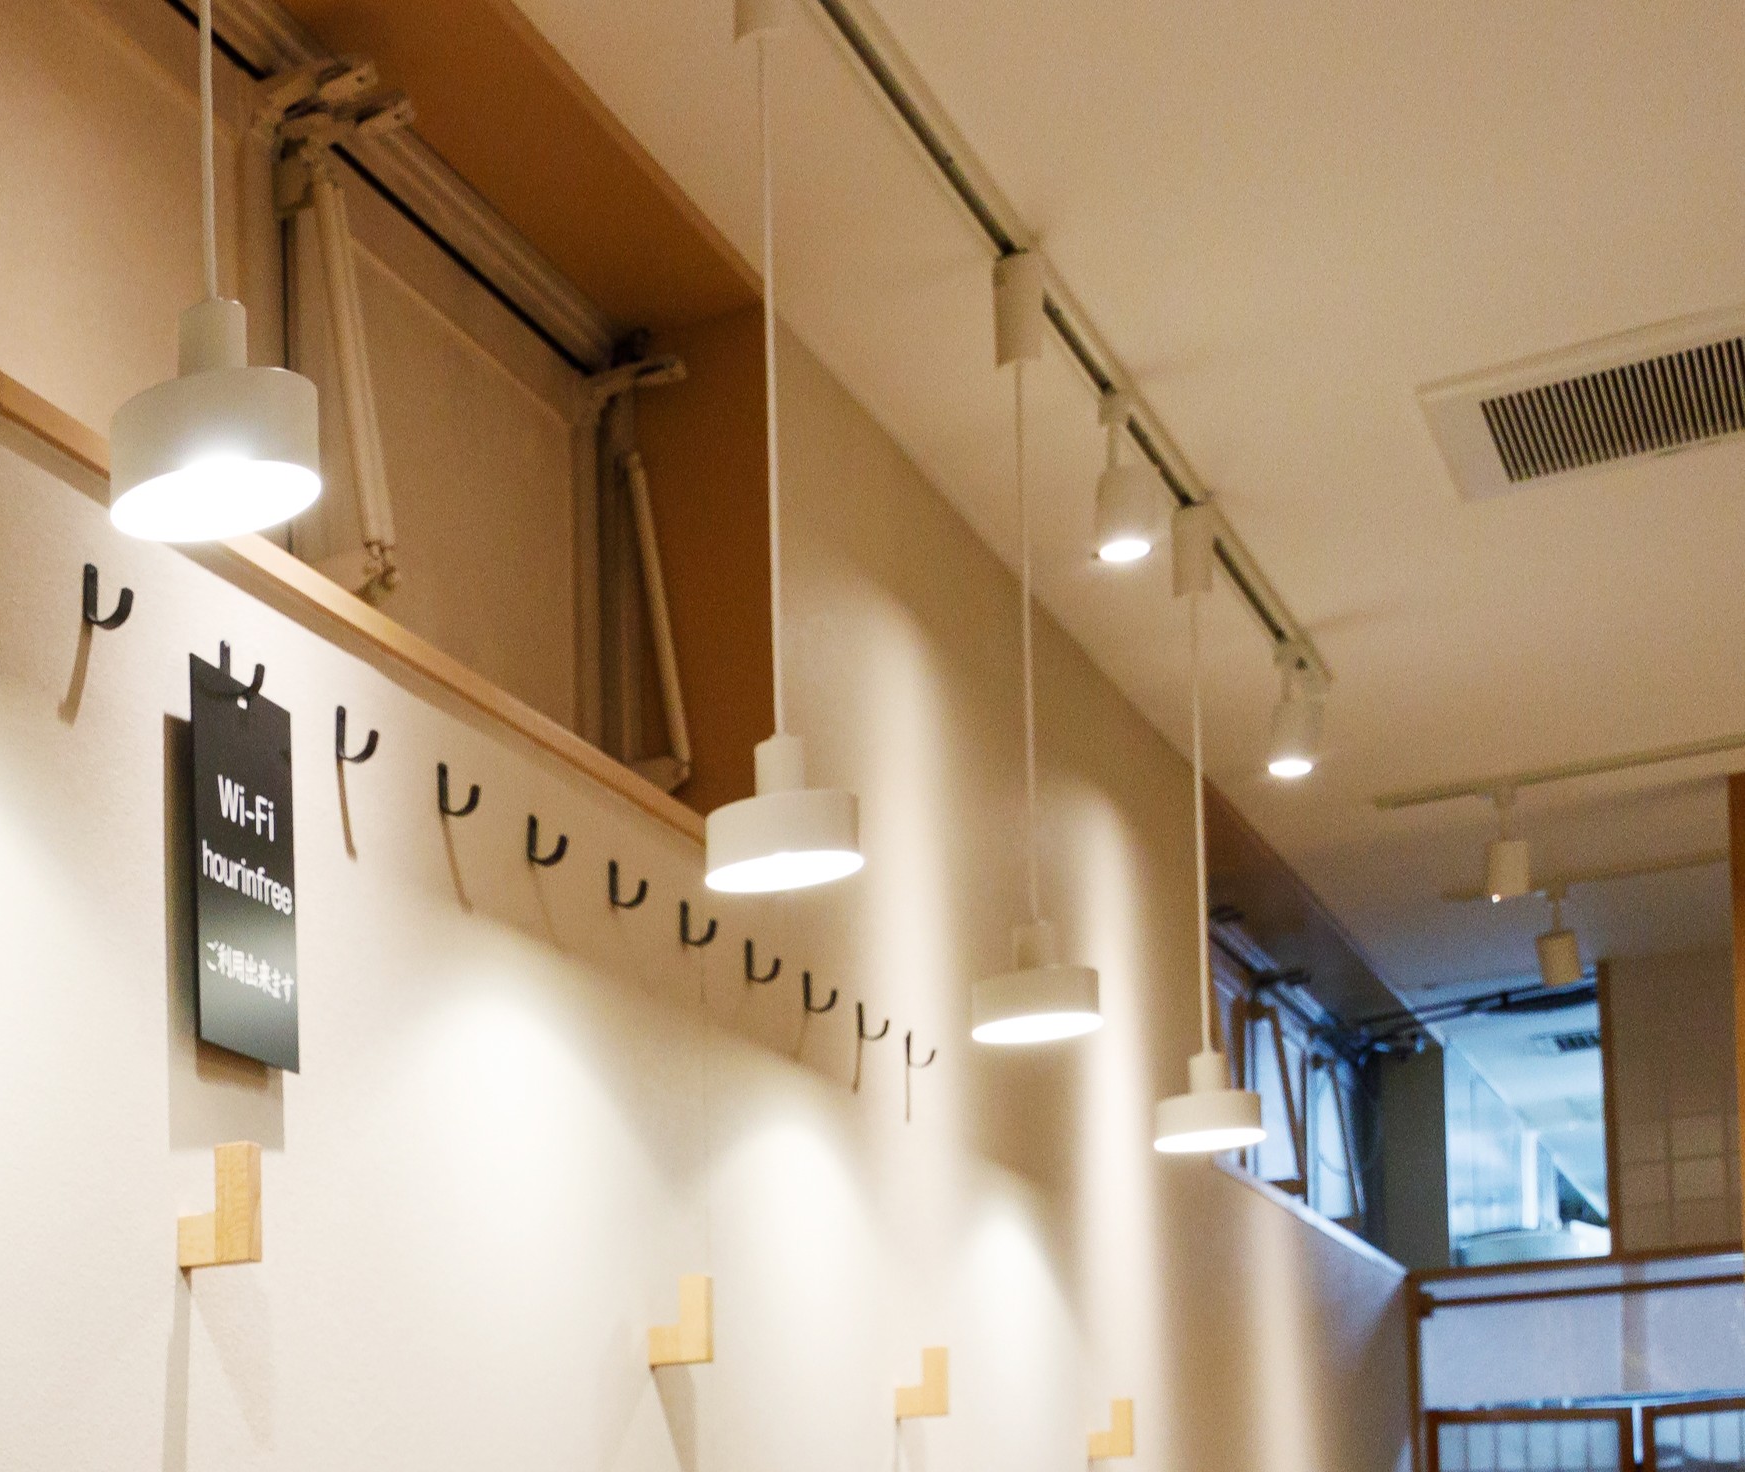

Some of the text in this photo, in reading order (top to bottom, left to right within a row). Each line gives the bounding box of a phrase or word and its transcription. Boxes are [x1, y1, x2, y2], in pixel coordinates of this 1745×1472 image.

[218, 773, 275, 842] Wi-Fi
[201, 839, 293, 916] hourinfree
[206, 940, 295, 1003] ご利用出来ます
